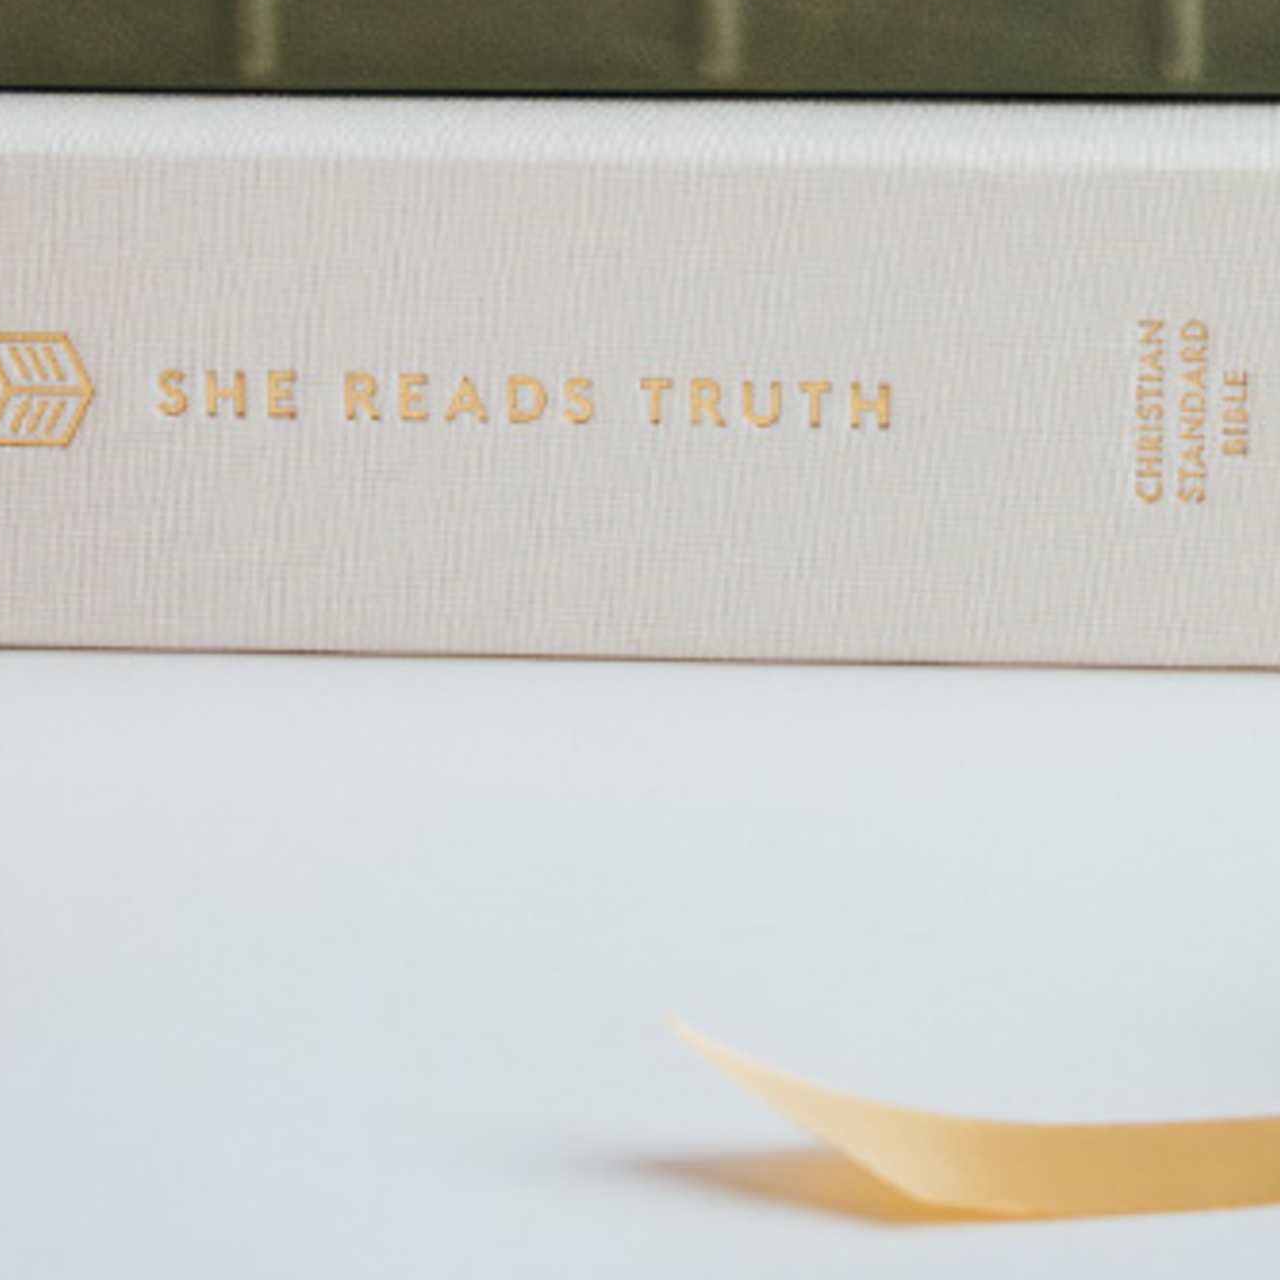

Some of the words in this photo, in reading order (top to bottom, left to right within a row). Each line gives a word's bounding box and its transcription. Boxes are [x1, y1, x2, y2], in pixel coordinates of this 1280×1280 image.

[156, 369, 300, 420] SHE
[343, 371, 597, 425] READS
[639, 376, 895, 431] TRUTH
[1135, 318, 1166, 505] CHRISTIAN
[1176, 318, 1210, 505] STANDARD
[1222, 369, 1249, 458] BIBLE
